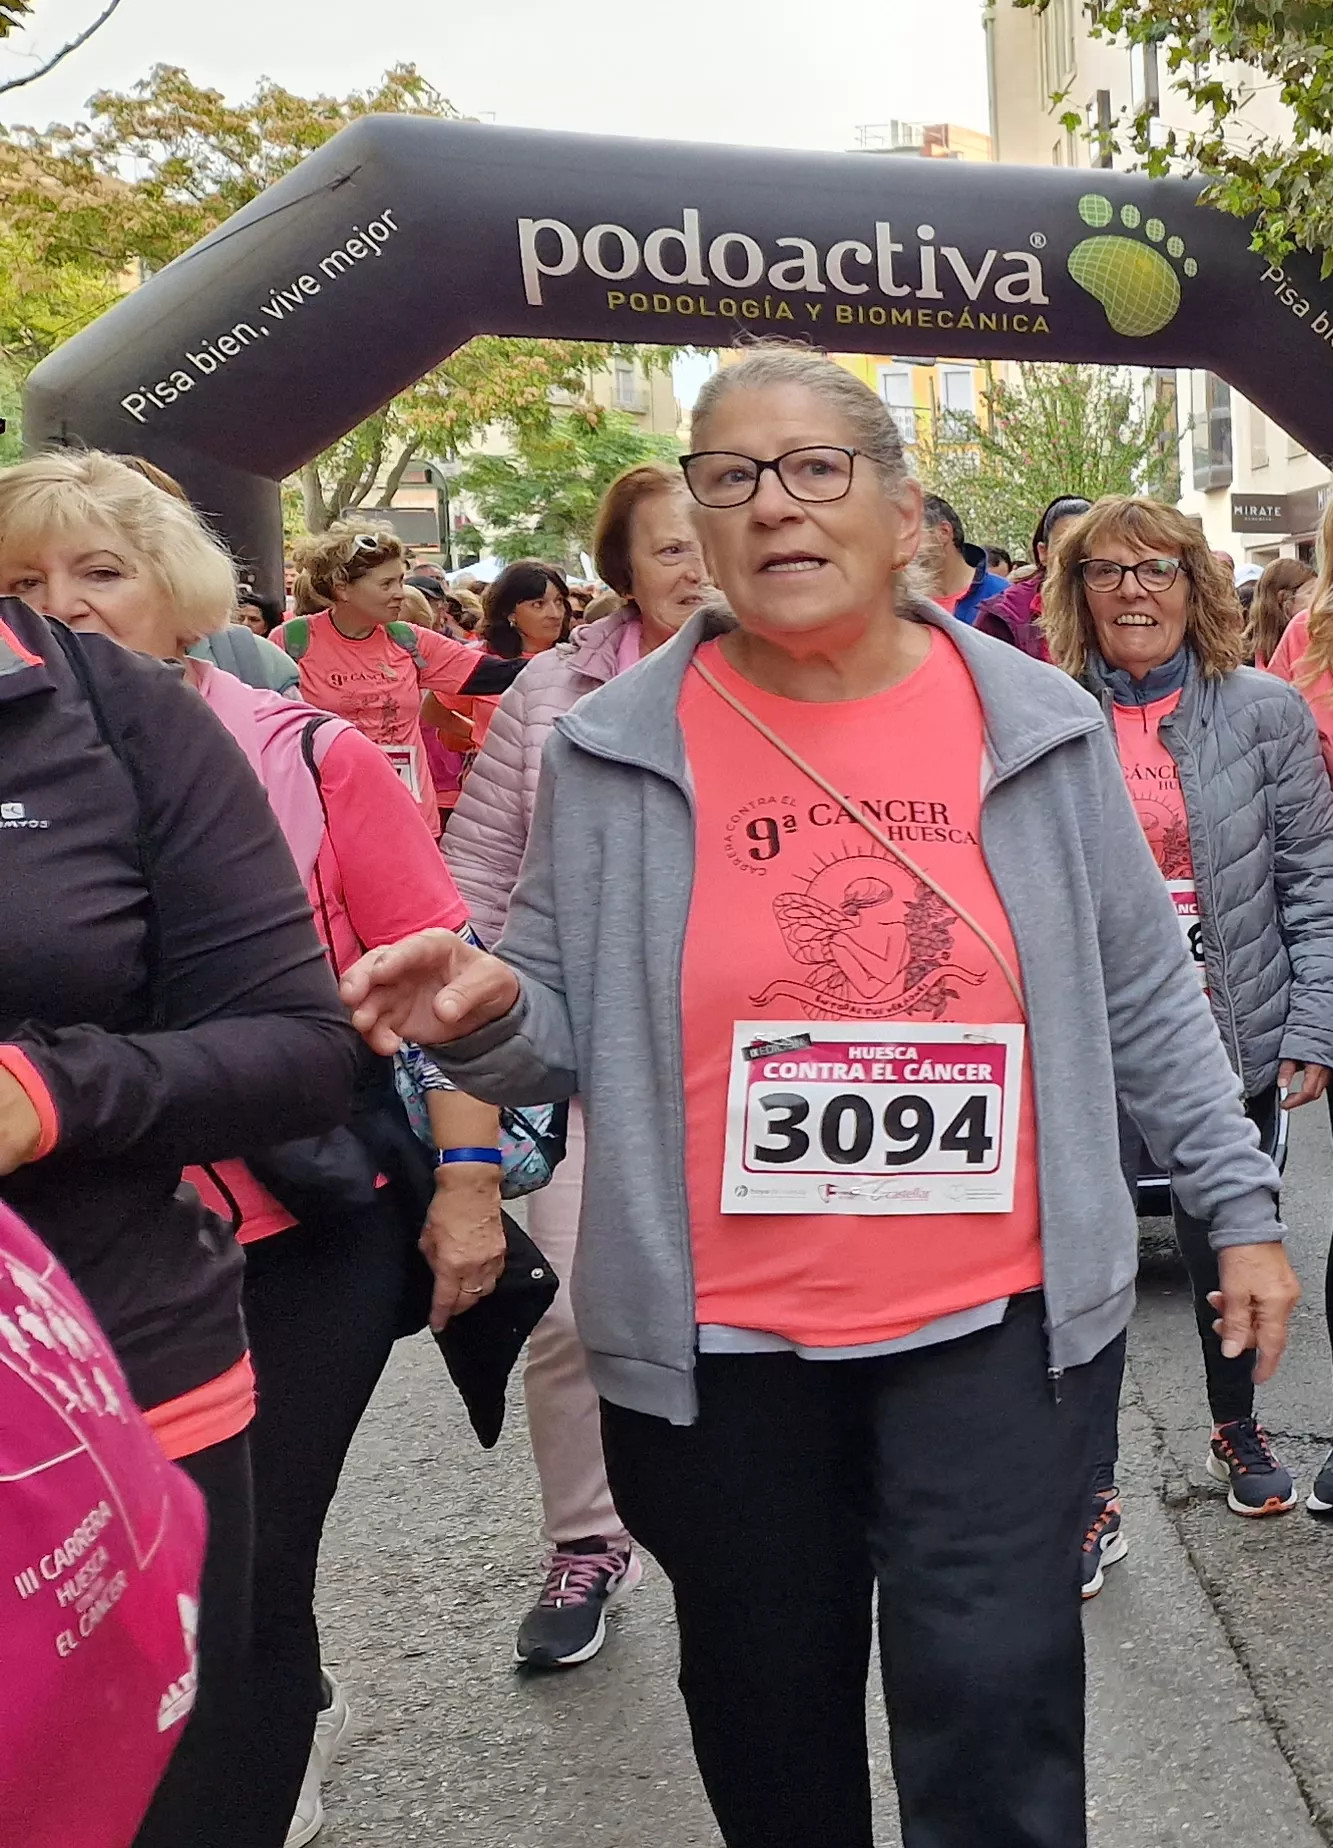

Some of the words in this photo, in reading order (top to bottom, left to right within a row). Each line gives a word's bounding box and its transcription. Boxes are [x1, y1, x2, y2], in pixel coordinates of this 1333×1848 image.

[1260, 265, 1310, 318] Pisa
[120, 370, 196, 424] Pisa
[185, 321, 270, 375] bien,
[260, 274, 321, 320] vive
[318, 208, 398, 279] mejor
[607, 291, 795, 320] PODOLOGÍA
[804, 302, 822, 322] Y
[835, 303, 1051, 333] BIOMECÁNICA
[1233, 505, 1282, 517] MIRATE
[725, 795, 777, 833] CONTRA
[745, 813, 799, 861] 9ª
[807, 795, 951, 827] CÁNCER
[887, 825, 979, 846] HUESCA
[763, 1062, 866, 1081] CONTRA
[871, 1064, 900, 1081] EL
[903, 1058, 993, 1082] CÁNCER
[848, 1045, 919, 1061] HUESCA
[753, 1092, 994, 1166] 3094
[14, 1566, 41, 1600] III
[40, 1500, 113, 1580] CARRERA
[56, 1629, 79, 1658] EL
